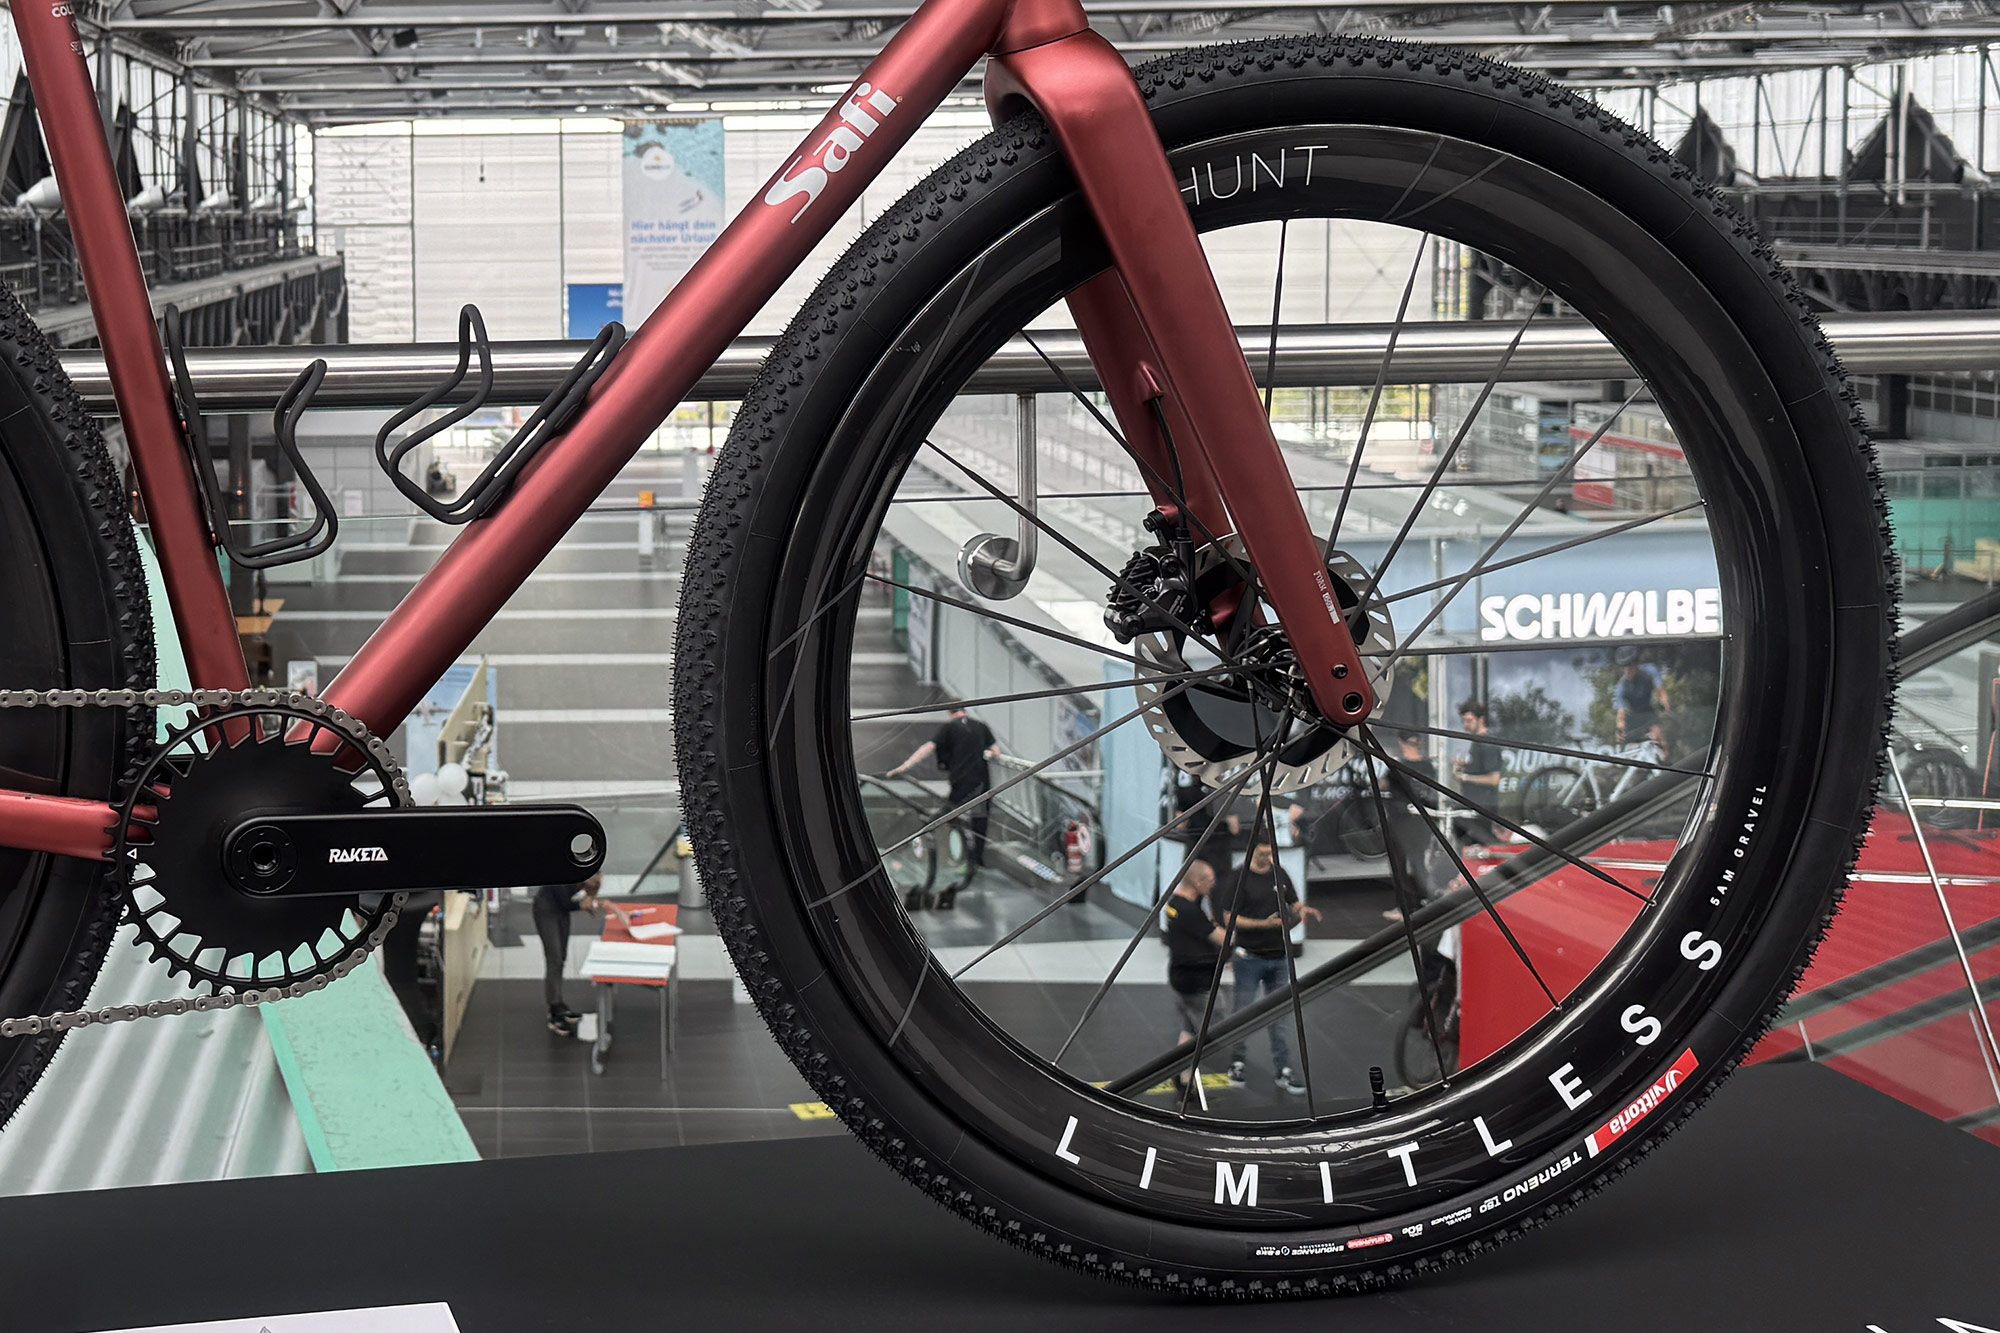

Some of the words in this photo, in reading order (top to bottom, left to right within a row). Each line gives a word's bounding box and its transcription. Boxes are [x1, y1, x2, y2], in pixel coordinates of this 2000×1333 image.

[764, 82, 898, 224] Safi
[630, 233, 677, 244] nächster
[631, 220, 655, 231] Hier
[658, 220, 689, 232] hängt
[693, 220, 717, 231] dein
[1480, 588, 1721, 642] SCHWALBE
[328, 847, 389, 863] RAKETA
[1709, 869, 1736, 907] 5AM
[1733, 785, 1768, 859] GRAVEL
[1055, 930, 1723, 1207] LIMITLESS
[1608, 1084, 1667, 1135] vittoria
[1503, 1150, 1583, 1203] TERRENO
[1291, 1245, 1345, 1257] ENDURANCE
